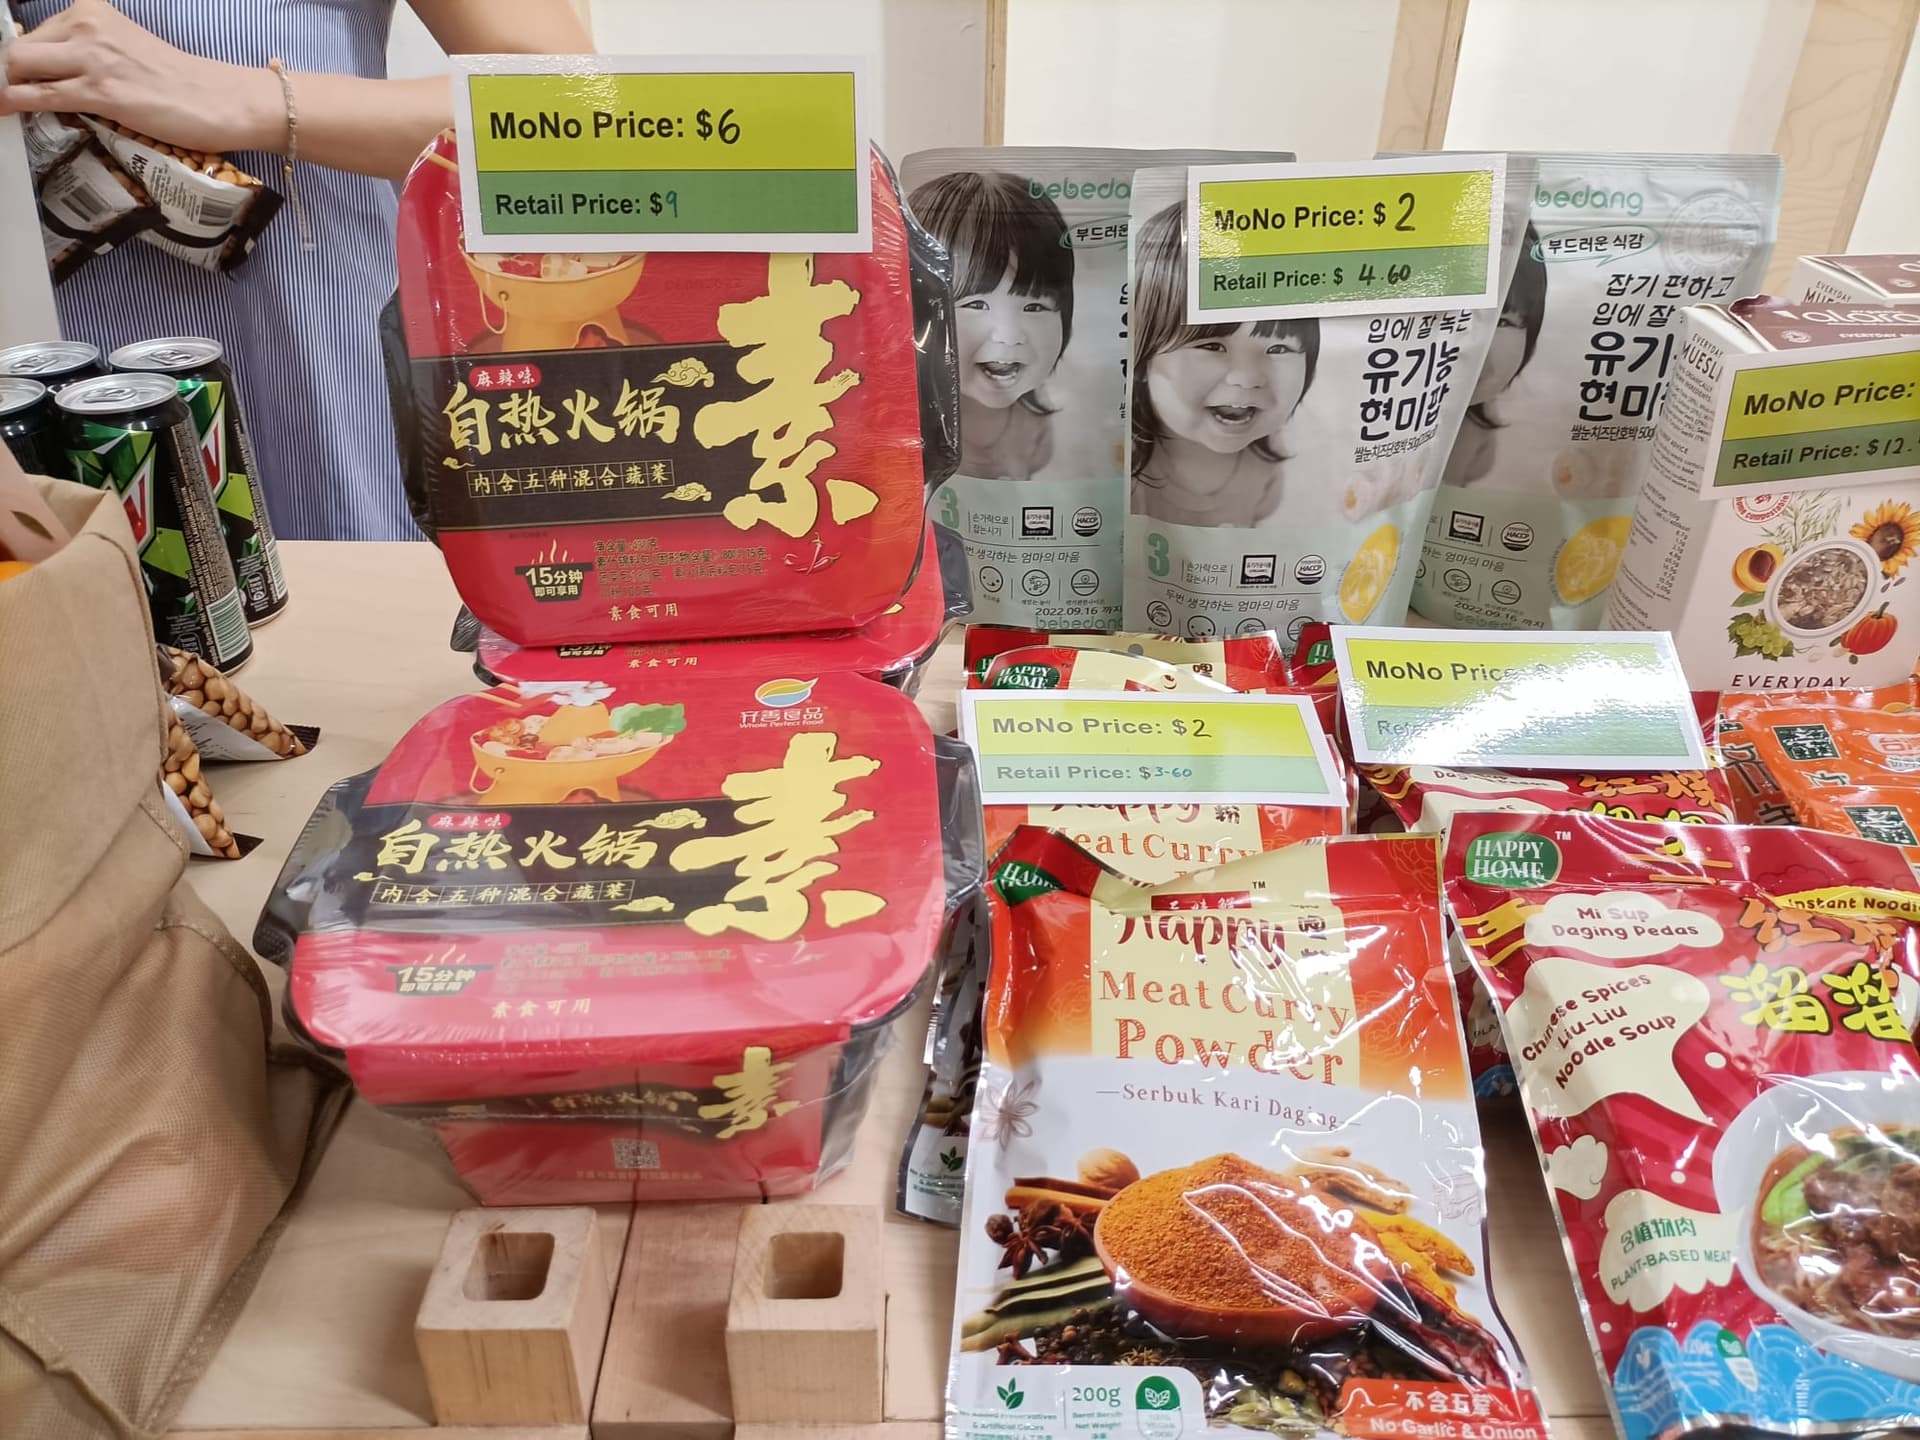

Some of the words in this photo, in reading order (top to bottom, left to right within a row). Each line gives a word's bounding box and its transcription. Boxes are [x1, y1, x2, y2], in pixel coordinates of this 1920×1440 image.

[490, 111, 582, 140] MoNo
[593, 111, 684, 139] Price:
[696, 107, 740, 144] $6
[495, 193, 563, 216] Retail
[572, 193, 641, 216] Price:
[649, 190, 678, 218] $9
[1214, 208, 1285, 231] MoNo
[1295, 206, 1364, 228] Price:
[1548, 235, 1608, 256] 부드러운
[1613, 233, 1644, 250] 식감
[1213, 273, 1266, 291] Retail
[1273, 270, 1326, 289] Price:
[1606, 274, 1659, 297] 잡기
[1662, 275, 1735, 300] 편하고
[1592, 302, 1644, 327] 입에
[1647, 304, 1676, 327] 잘
[1368, 317, 1415, 343] 입에
[1417, 314, 1437, 339] 잘
[1439, 309, 1473, 334] 녹는
[1692, 333, 1724, 357] EVERYDAY
[1362, 340, 1460, 394] 유기농
[1682, 340, 1724, 382] MUESLI
[476, 368, 536, 388] 麻辣味
[693, 252, 880, 539] 素
[1744, 389, 1825, 415] MoNo
[1834, 381, 1915, 406] Price:
[442, 379, 681, 456] 自热火锅
[1360, 383, 1450, 441] 현미팝
[1733, 449, 1793, 469] Retail
[1800, 443, 1860, 462] Price:
[473, 462, 669, 494] 内含五种混合蔬菜
[941, 487, 960, 529] 3
[972, 512, 1009, 525] 손가락으로
[1506, 531, 1530, 539] HACCP
[977, 550, 1018, 563] 생각하는
[1022, 551, 1054, 563] 엄마의
[1058, 551, 1080, 563] 마음
[1148, 532, 1170, 577] 3
[1445, 551, 1481, 567] 엄마의
[1482, 558, 1505, 571] 마음
[524, 567, 584, 587] 15分钟
[1186, 561, 1228, 573] 손가락으로
[1300, 564, 1322, 572] HACCP
[1186, 573, 1218, 585] 잡는시기
[534, 585, 578, 597] 即可享用
[608, 602, 680, 621] 素食可用
[1035, 607, 1098, 616] 2022.09.16
[1188, 598, 1234, 612] 생각하는
[1238, 600, 1273, 612] 엄마의
[1276, 599, 1301, 611] 마음
[1453, 600, 1518, 622] 2022.09.16
[628, 656, 698, 669] 素食可用
[1000, 665, 1050, 677] HAPPY
[1366, 660, 1443, 681] MoNo
[998, 674, 1049, 690] HOME
[1731, 674, 1851, 689] EVERYDAY
[769, 720, 800, 728] Perfect
[992, 717, 1073, 735] MoNo
[1083, 717, 1163, 735] Price:
[996, 765, 1061, 780] Retail
[1068, 765, 1131, 780] Price:
[434, 814, 504, 828] 麻辣味
[376, 818, 659, 875] 自热火锅
[669, 731, 888, 942] 素
[1476, 839, 1544, 861] HAPPY
[1555, 830, 1571, 841] TM
[1472, 859, 1544, 880] HOME
[381, 882, 627, 904] 内含五种混合蔬菜
[1253, 881, 1266, 889] TM
[1578, 906, 1602, 921] Mi
[1610, 907, 1648, 924] Sup
[1552, 923, 1628, 940] Daging
[1634, 922, 1699, 938] Pedas
[397, 967, 477, 983] 15分钟
[400, 981, 464, 992] 即可享用
[491, 998, 592, 1018] 素食可用
[1099, 969, 1212, 1010] Meat
[1221, 980, 1351, 1037] Curry
[1522, 999, 1578, 1062] Chinese
[1581, 974, 1652, 1004] Spices
[1557, 1005, 1628, 1050] Liu-Liu
[1619, 1015, 1677, 1041] Soup
[1114, 1017, 1343, 1086] Powder
[1122, 1083, 1201, 1106] Serbuk
[1214, 1090, 1261, 1112] Kari
[1269, 1098, 1338, 1132] Daging
[1610, 1249, 1700, 1290] PLANT-BASED
[1704, 1249, 1732, 1263] MEAT
[1072, 1386, 1121, 1408] 200g
[1371, 1418, 1395, 1433] No
[1402, 1419, 1456, 1437] Garlic
[1462, 1424, 1475, 1438] &
[1481, 1423, 1537, 1440] Onion
